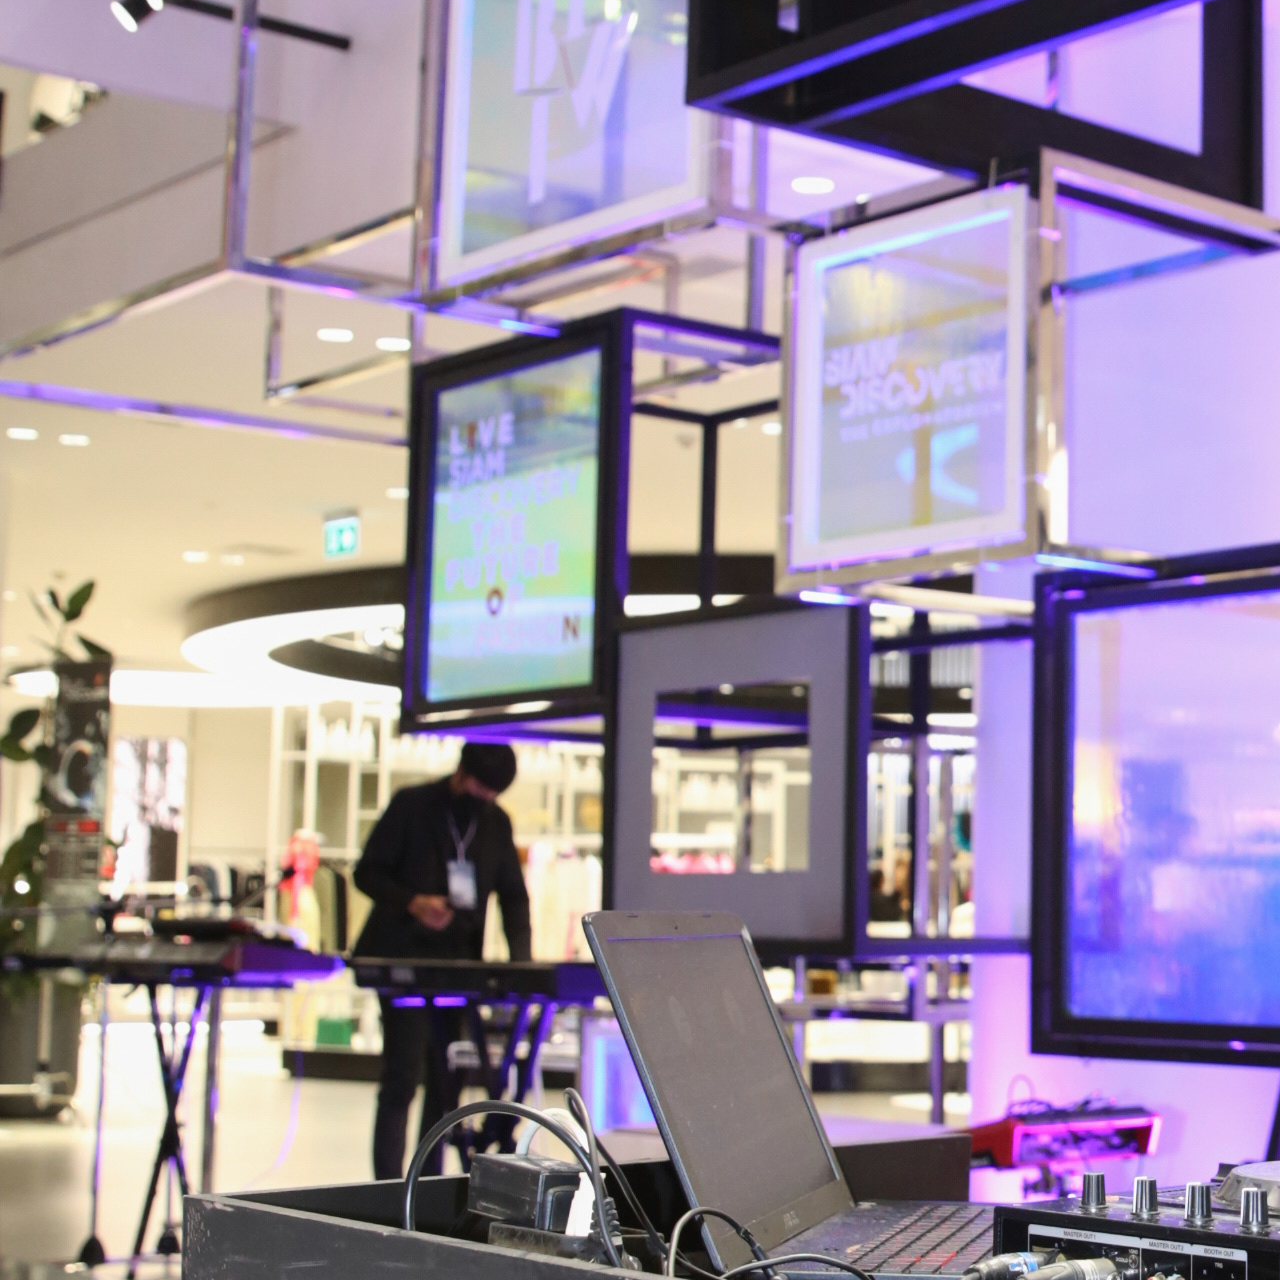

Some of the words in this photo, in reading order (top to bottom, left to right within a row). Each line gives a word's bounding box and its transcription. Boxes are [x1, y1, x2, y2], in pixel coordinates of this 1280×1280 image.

[451, 411, 515, 455] LIVE
[451, 449, 507, 490] SIAM
[450, 463, 582, 521] DISCOVERY
[470, 512, 526, 552] THE
[445, 540, 560, 591] FUTURE
[1149, 1241, 1170, 1250] MASTER
[1204, 1248, 1220, 1256] BOOTH
[1221, 1250, 1235, 1258] OUT
